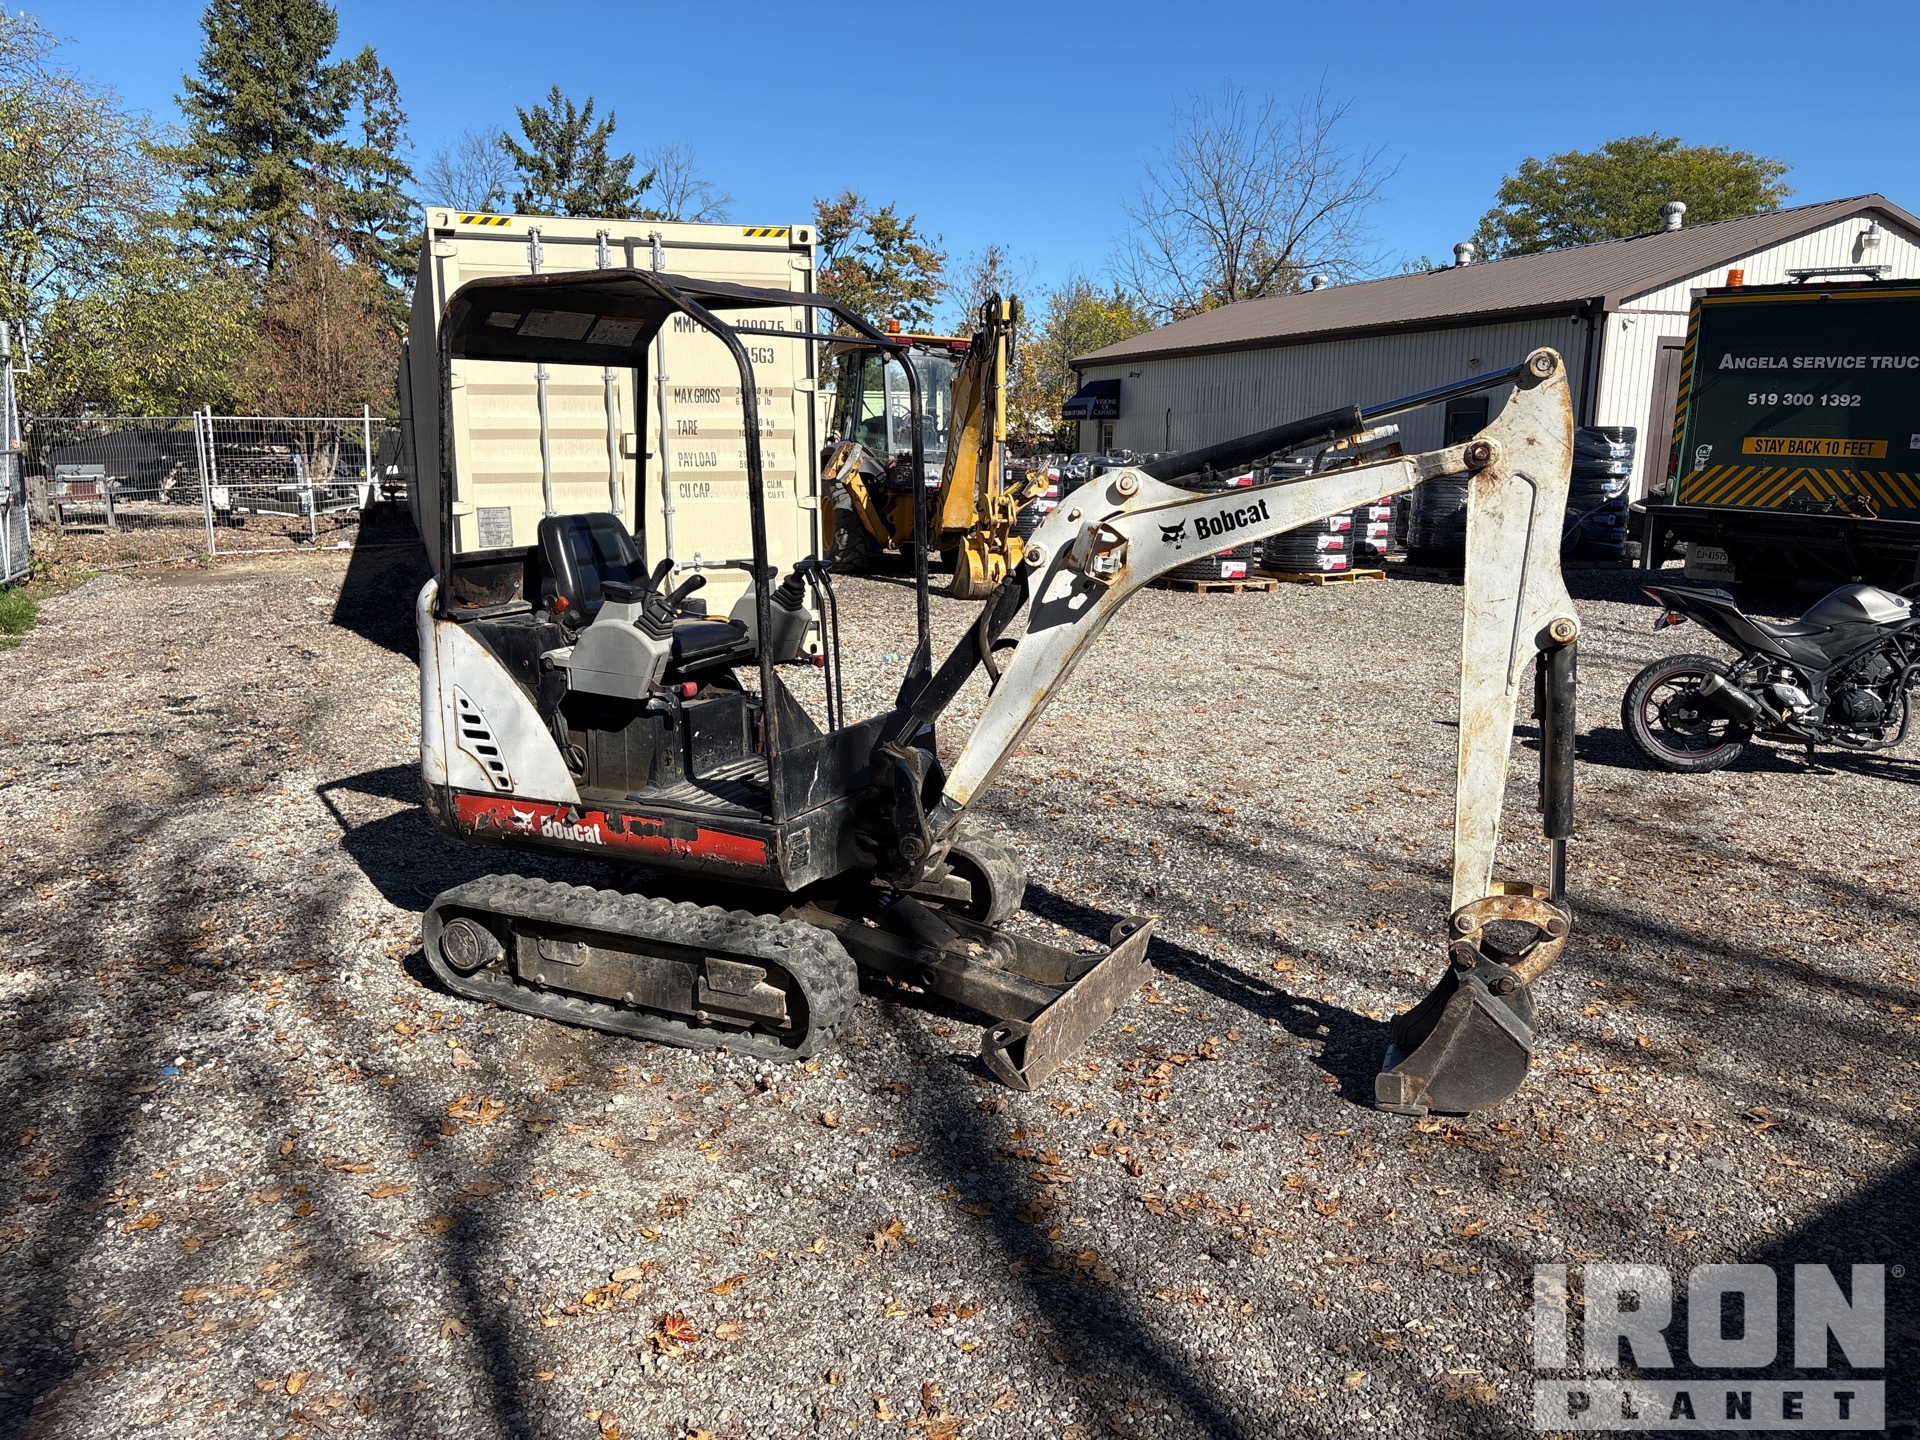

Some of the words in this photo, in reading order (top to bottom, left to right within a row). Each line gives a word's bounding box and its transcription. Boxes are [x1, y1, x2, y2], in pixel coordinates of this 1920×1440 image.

[1718, 353, 1789, 369] ANGELA
[1792, 356, 1867, 369] SERVICE
[764, 387, 773, 397] kg
[1747, 393, 1779, 405] 519
[1782, 393, 1814, 406] 300
[1820, 394, 1862, 407] 1392
[677, 420, 698, 436] TARE
[1755, 439, 1785, 453] STAY
[1787, 440, 1822, 454] BACK
[1825, 441, 1840, 454] 10
[1843, 441, 1875, 456] FEET
[678, 452, 717, 467] PAYLOAD
[1193, 499, 1270, 540] Bobcat
[540, 815, 603, 845] Bobcat
